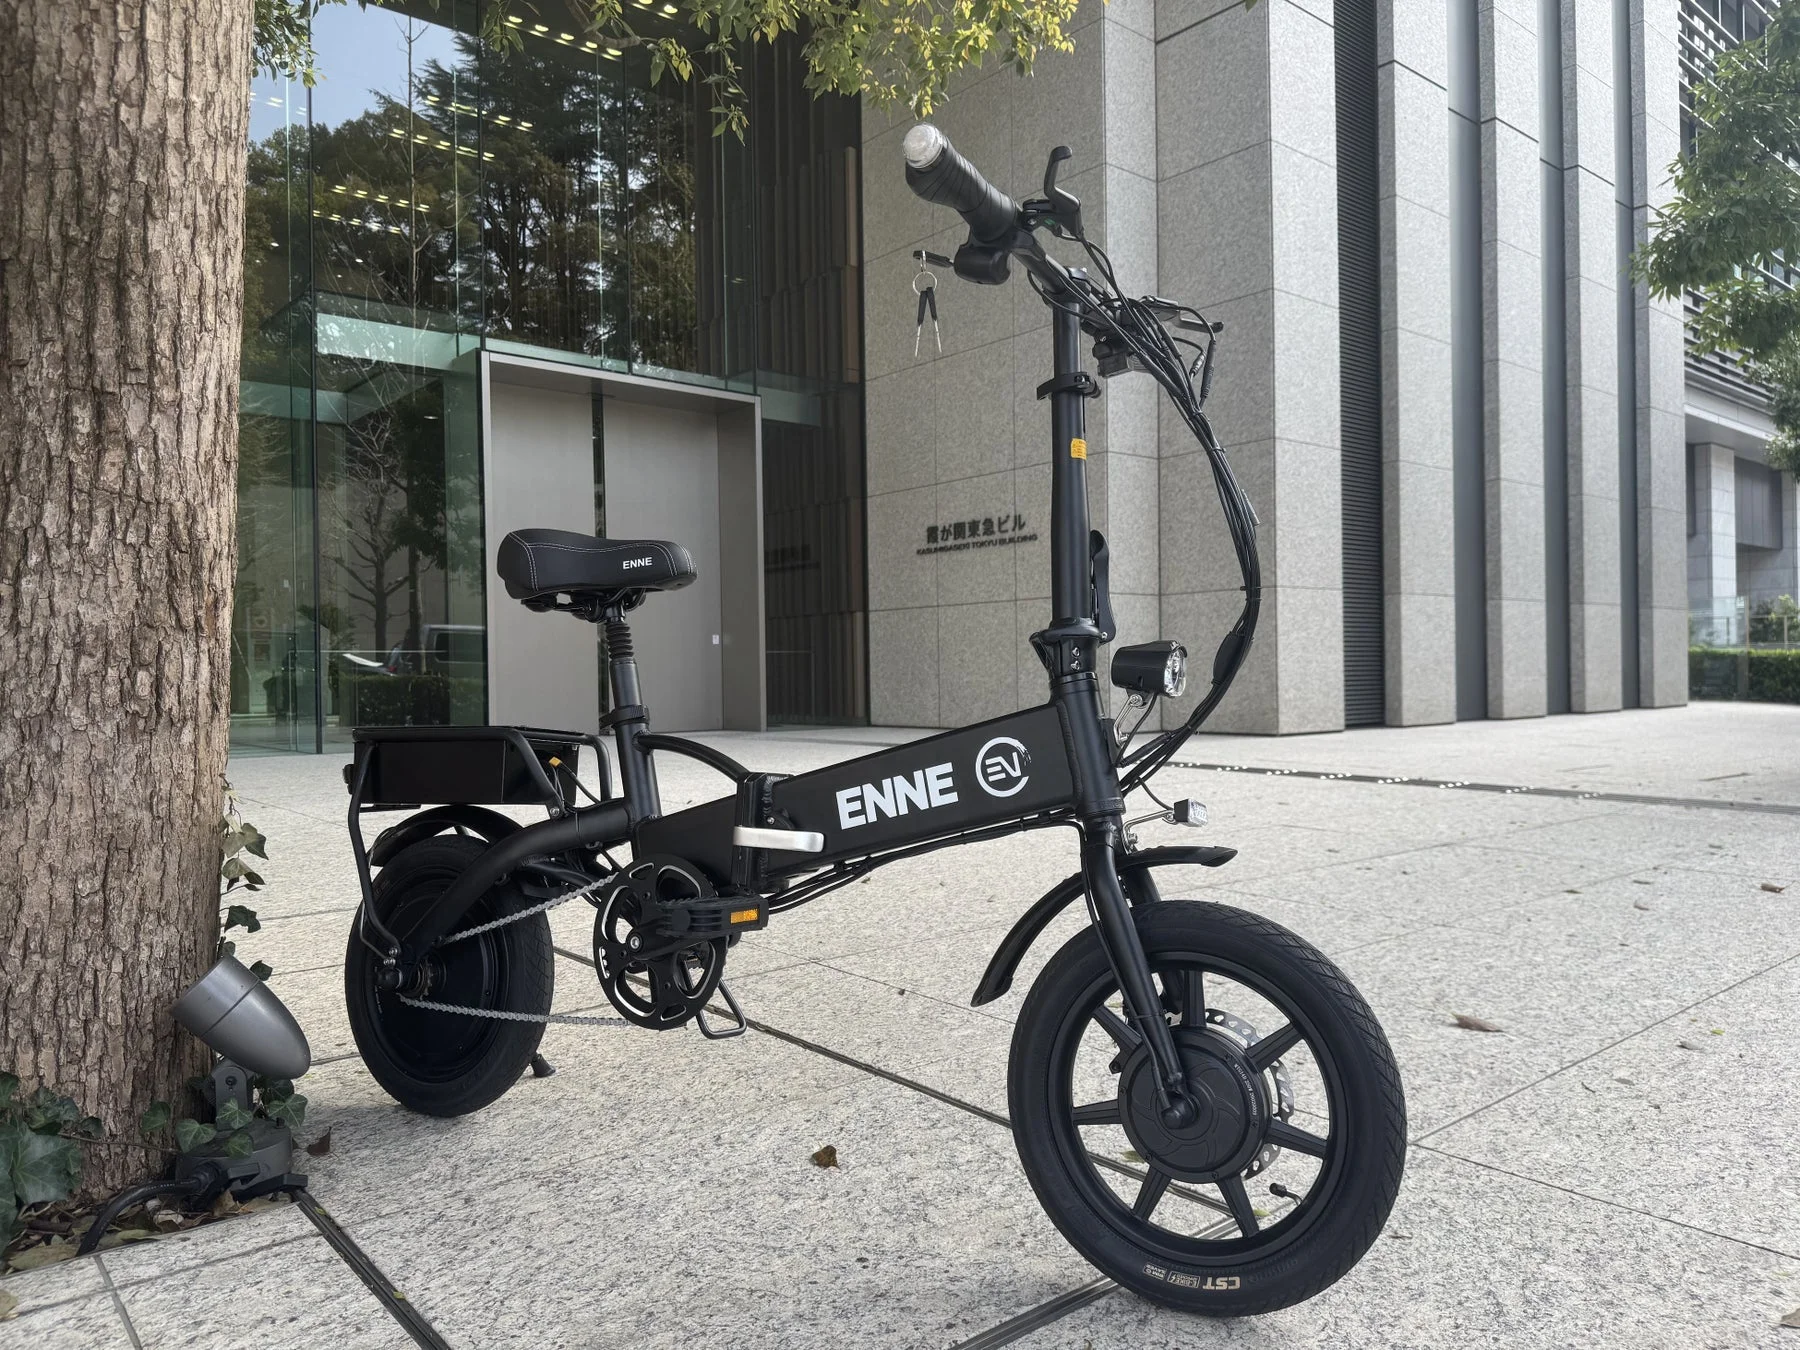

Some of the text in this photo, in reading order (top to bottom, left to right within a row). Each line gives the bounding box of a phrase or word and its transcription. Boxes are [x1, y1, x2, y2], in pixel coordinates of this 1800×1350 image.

[926, 514, 1026, 544] 霞が関東急ビル
[972, 538, 998, 549] TOKYU
[999, 533, 1038, 546] BUILDING
[623, 557, 653, 570] ENNE
[836, 752, 1022, 830] ENNE EV
[1202, 1276, 1241, 1290] CST
